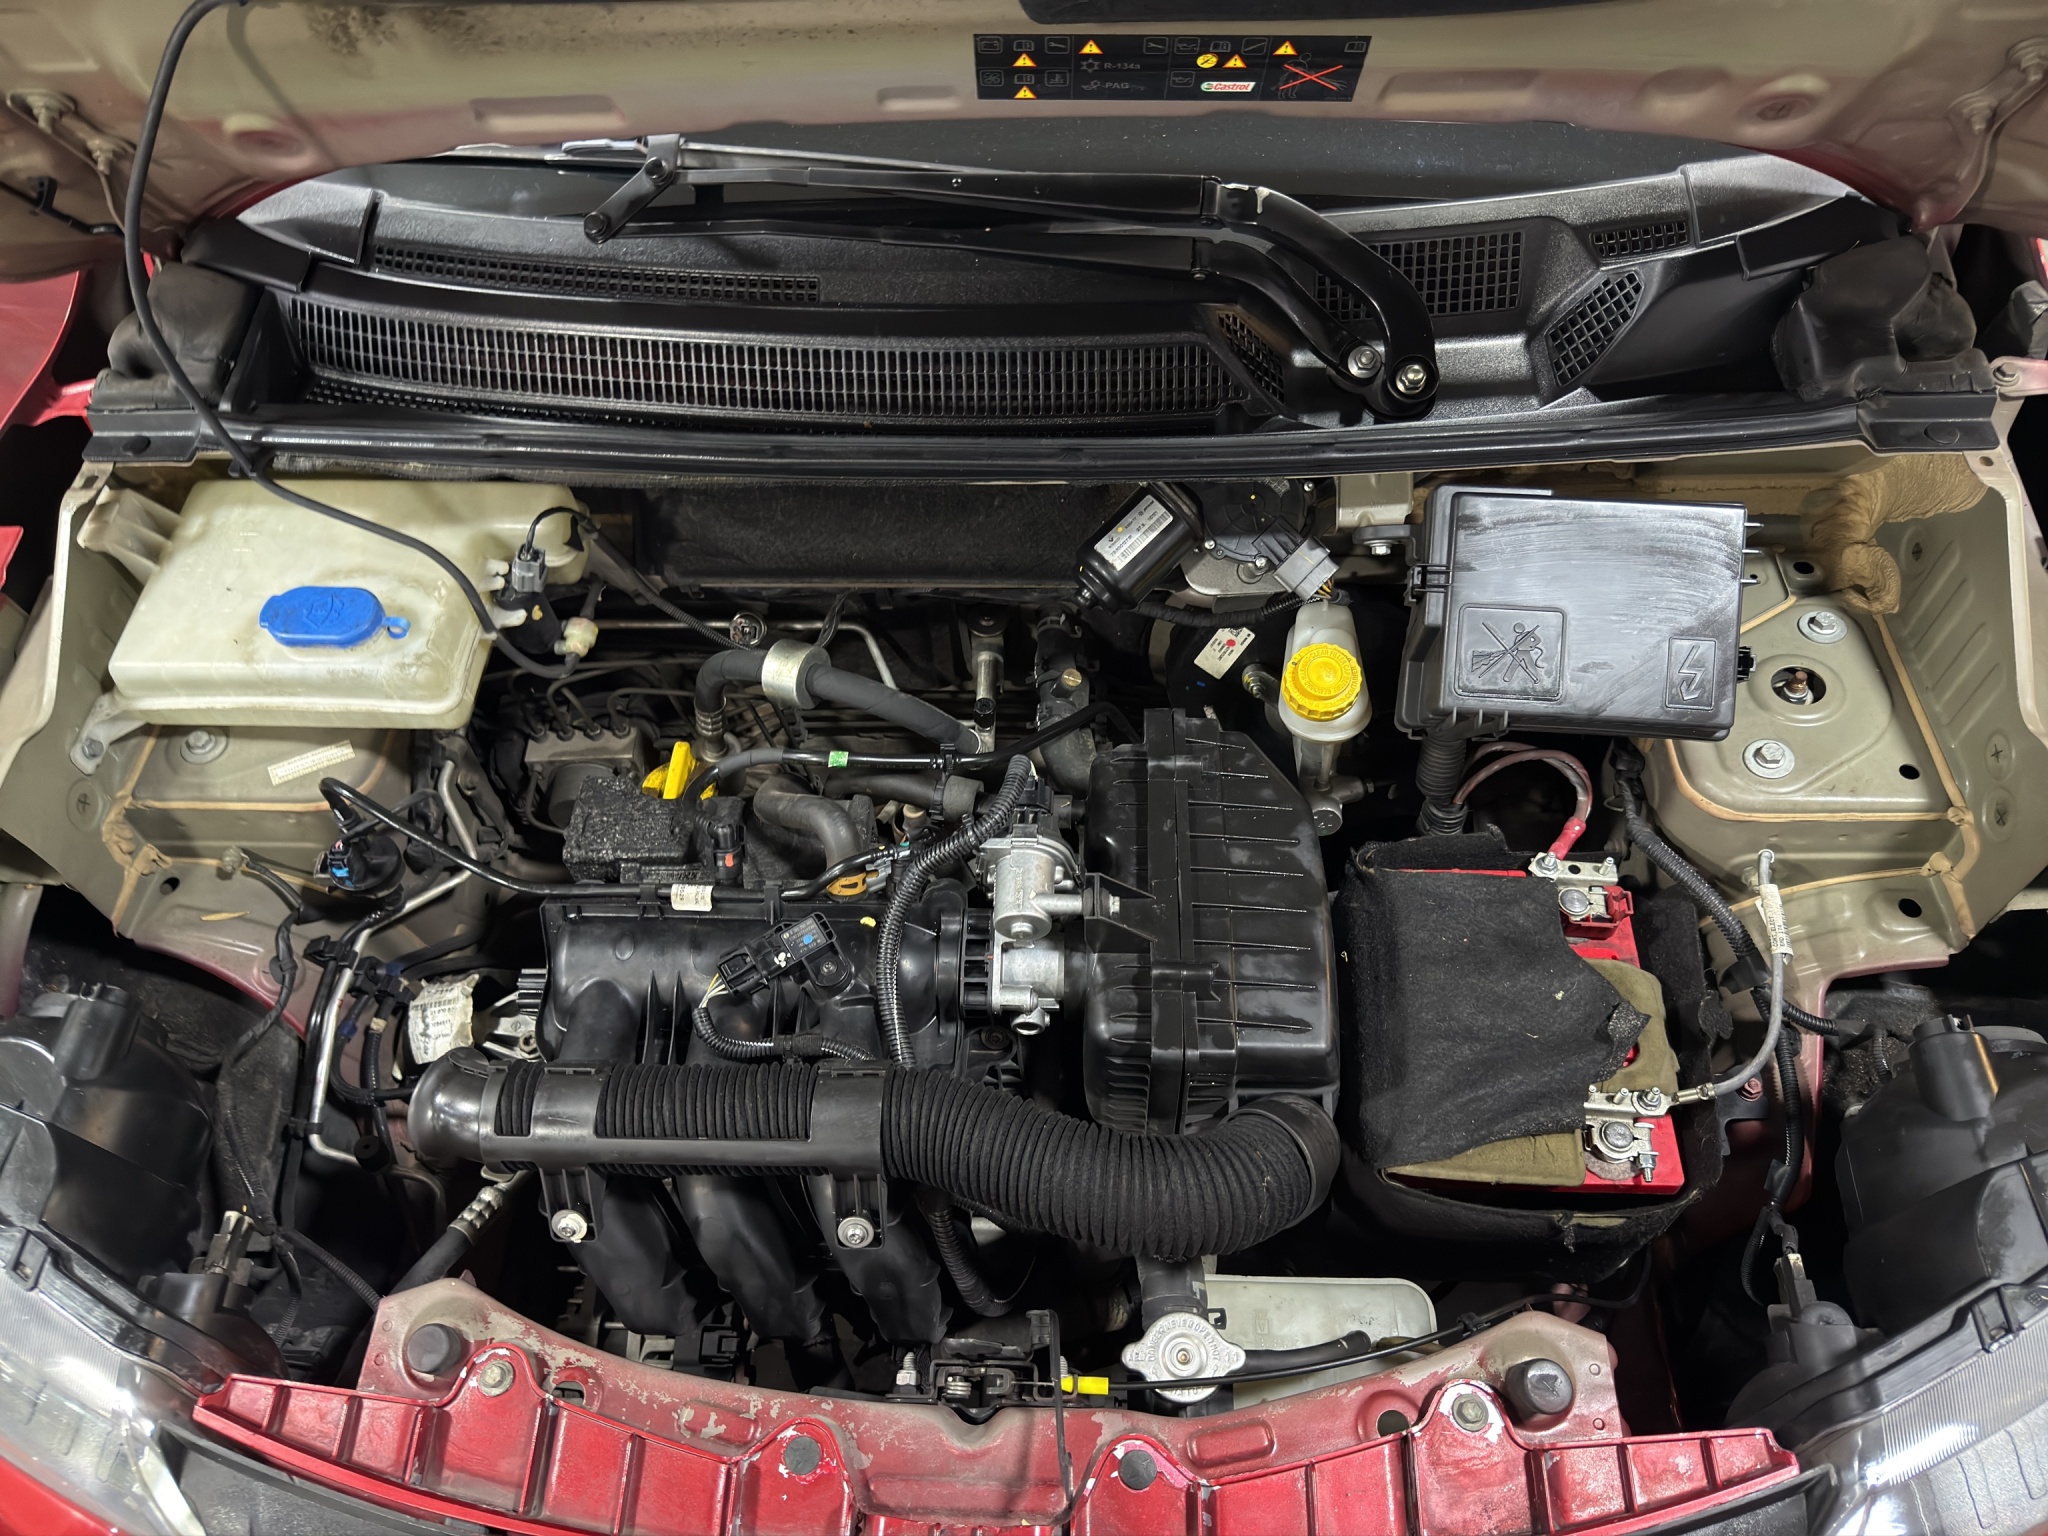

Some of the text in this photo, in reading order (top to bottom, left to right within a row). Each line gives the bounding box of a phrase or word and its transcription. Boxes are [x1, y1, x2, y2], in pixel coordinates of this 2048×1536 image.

[1104, 62, 1141, 70] R-134a
[1213, 82, 1250, 91] Castrol
[1309, 649, 1329, 659] CLEAR
[1329, 650, 1347, 665] FILLER
[1345, 665, 1359, 700] CONTAINER
[1146, 1324, 1165, 1361] DANGER
[1164, 1318, 1194, 1330] NEVER
[1194, 1322, 1214, 1345] OPEN
[1210, 1345, 1220, 1361] HOT
